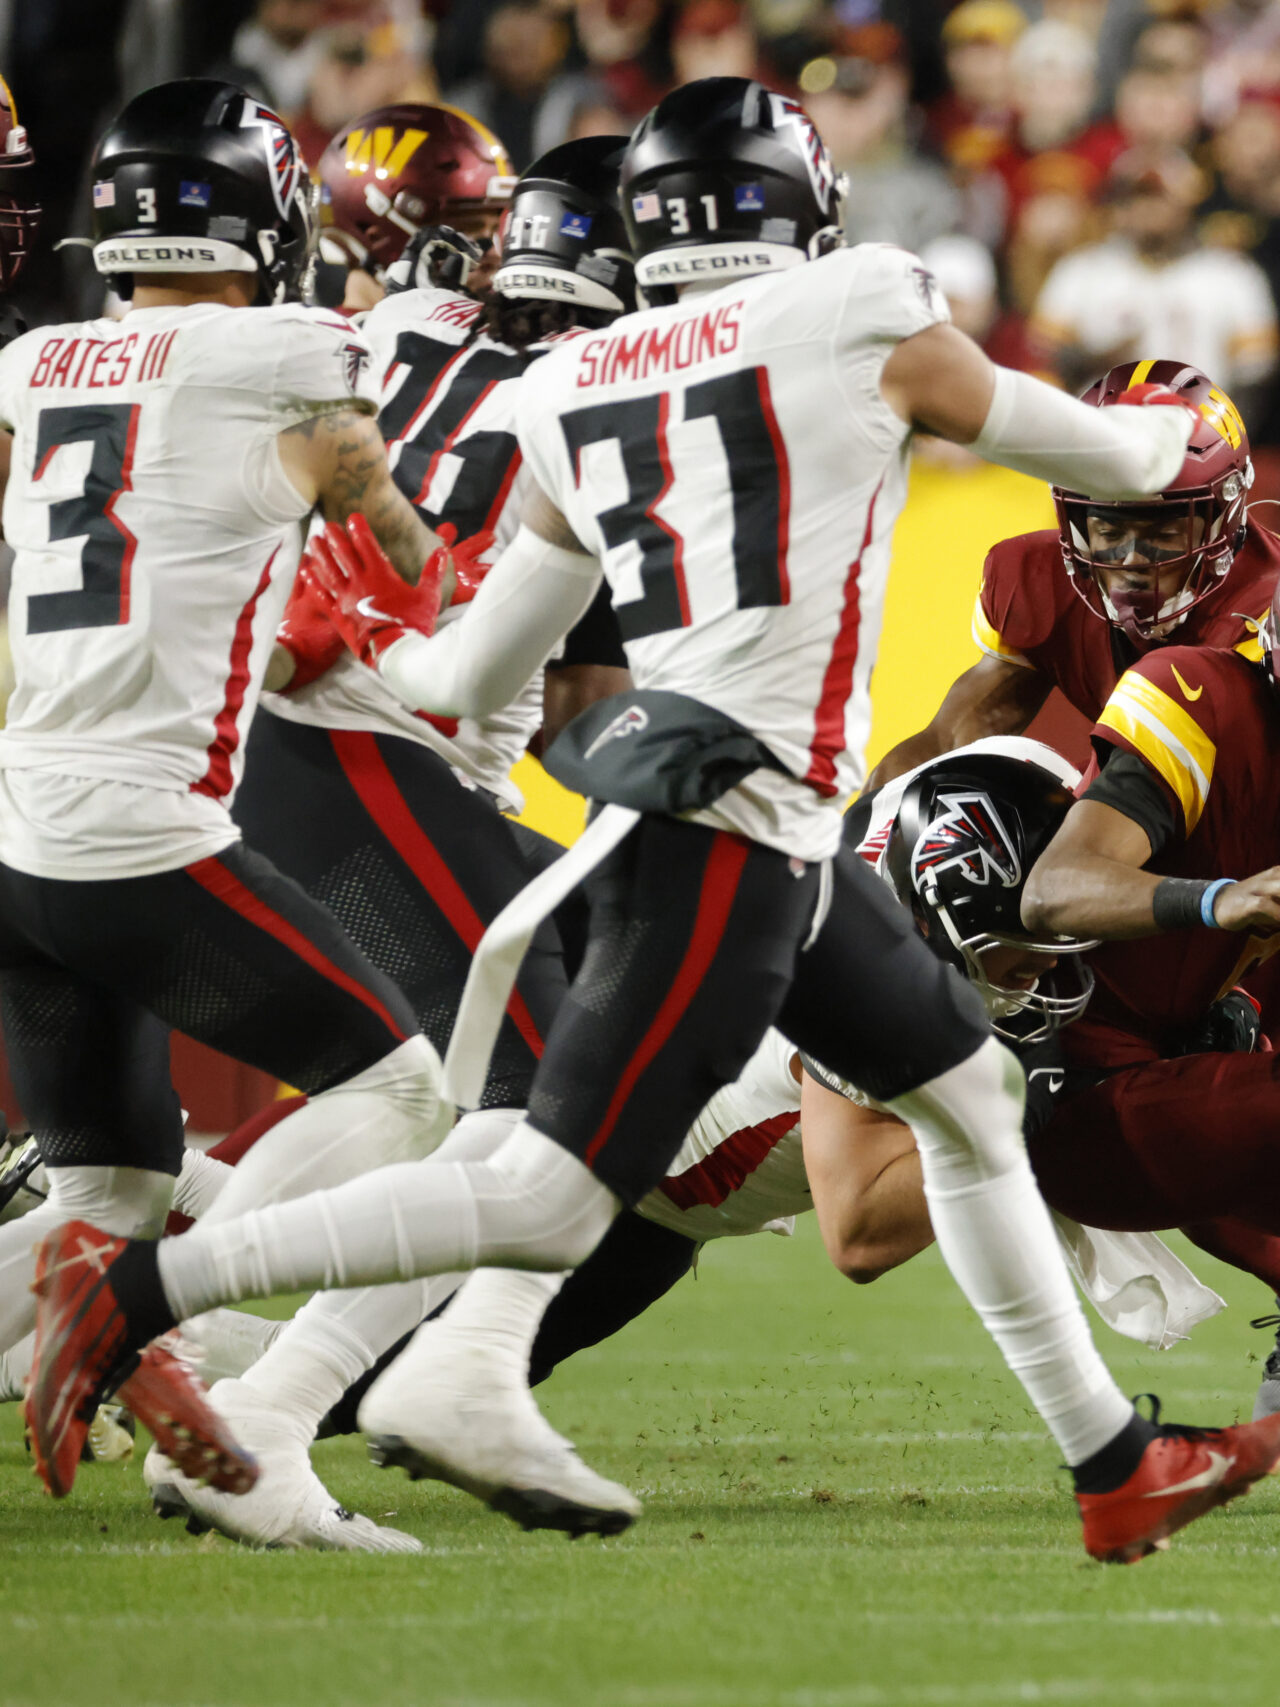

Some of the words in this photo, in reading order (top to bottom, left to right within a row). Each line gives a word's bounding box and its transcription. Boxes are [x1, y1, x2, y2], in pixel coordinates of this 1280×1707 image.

[136, 188, 157, 223] 3
[667, 195, 718, 234] 31
[99, 247, 216, 262] FALCONS
[645, 254, 771, 279] FALCONS
[499, 274, 576, 295] LCONS
[30, 334, 139, 388] BATES
[139, 329, 180, 382] III
[577, 302, 743, 389] SIMMONS
[27, 403, 141, 635] 3
[559, 365, 791, 644] 31
